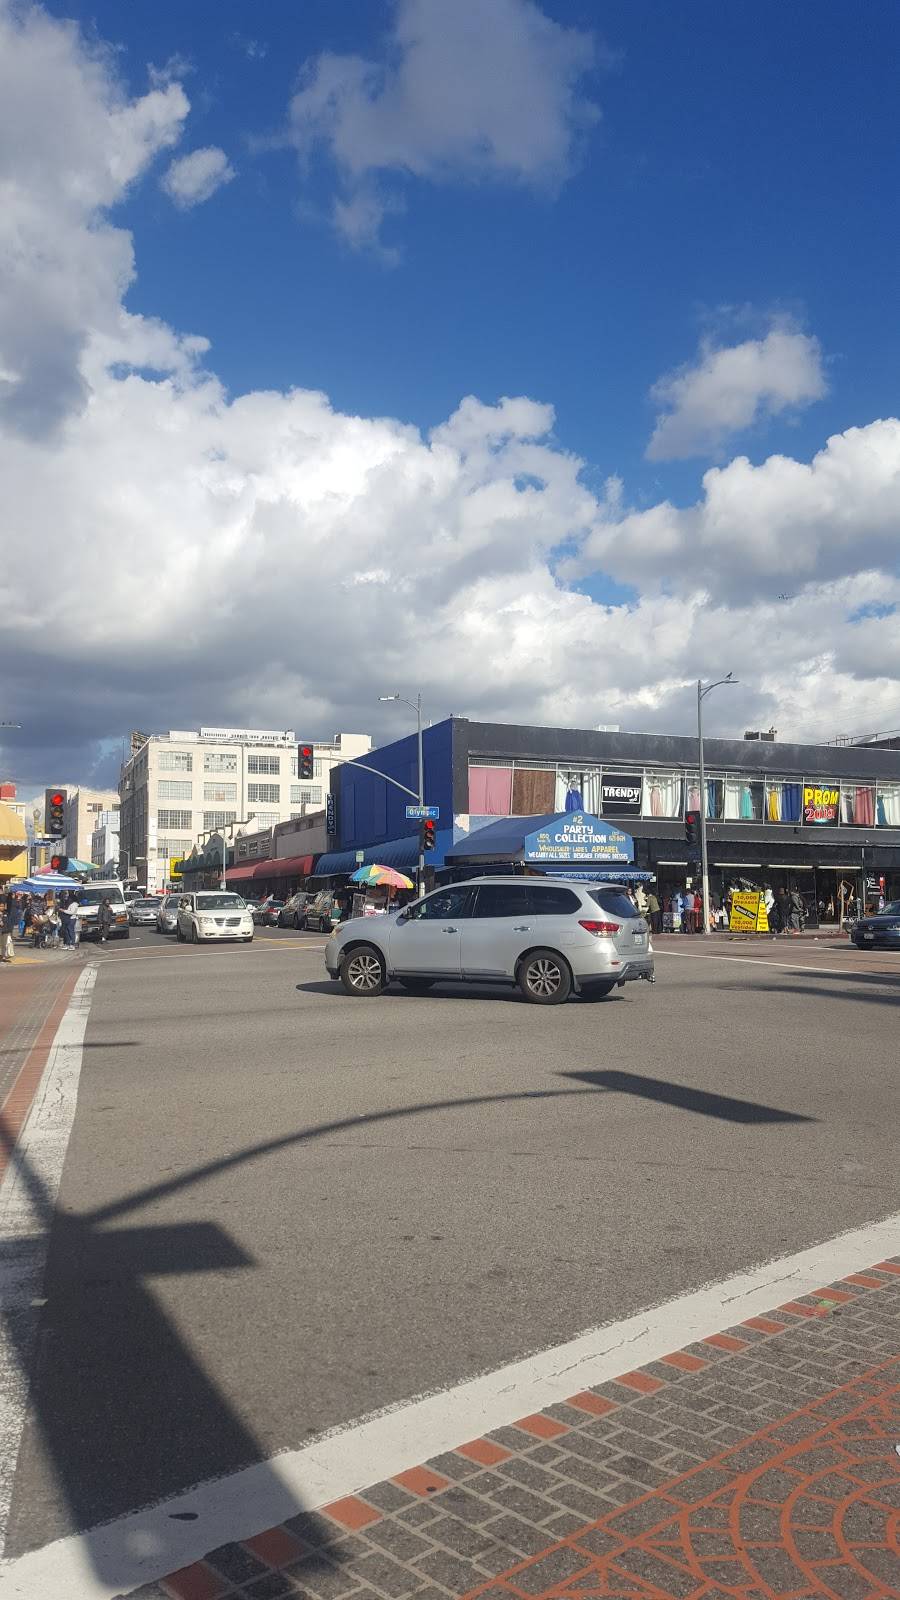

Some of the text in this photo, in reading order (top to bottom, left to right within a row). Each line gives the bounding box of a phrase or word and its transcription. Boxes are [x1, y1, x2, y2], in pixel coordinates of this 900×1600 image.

[604, 787, 639, 798] TRENDY
[804, 788, 839, 806] PROM
[409, 808, 436, 817] Olympic
[573, 816, 583, 824] #2
[564, 825, 593, 834] PARTY
[555, 834, 606, 843] COLLECTION
[591, 845, 619, 854] APPAREL
